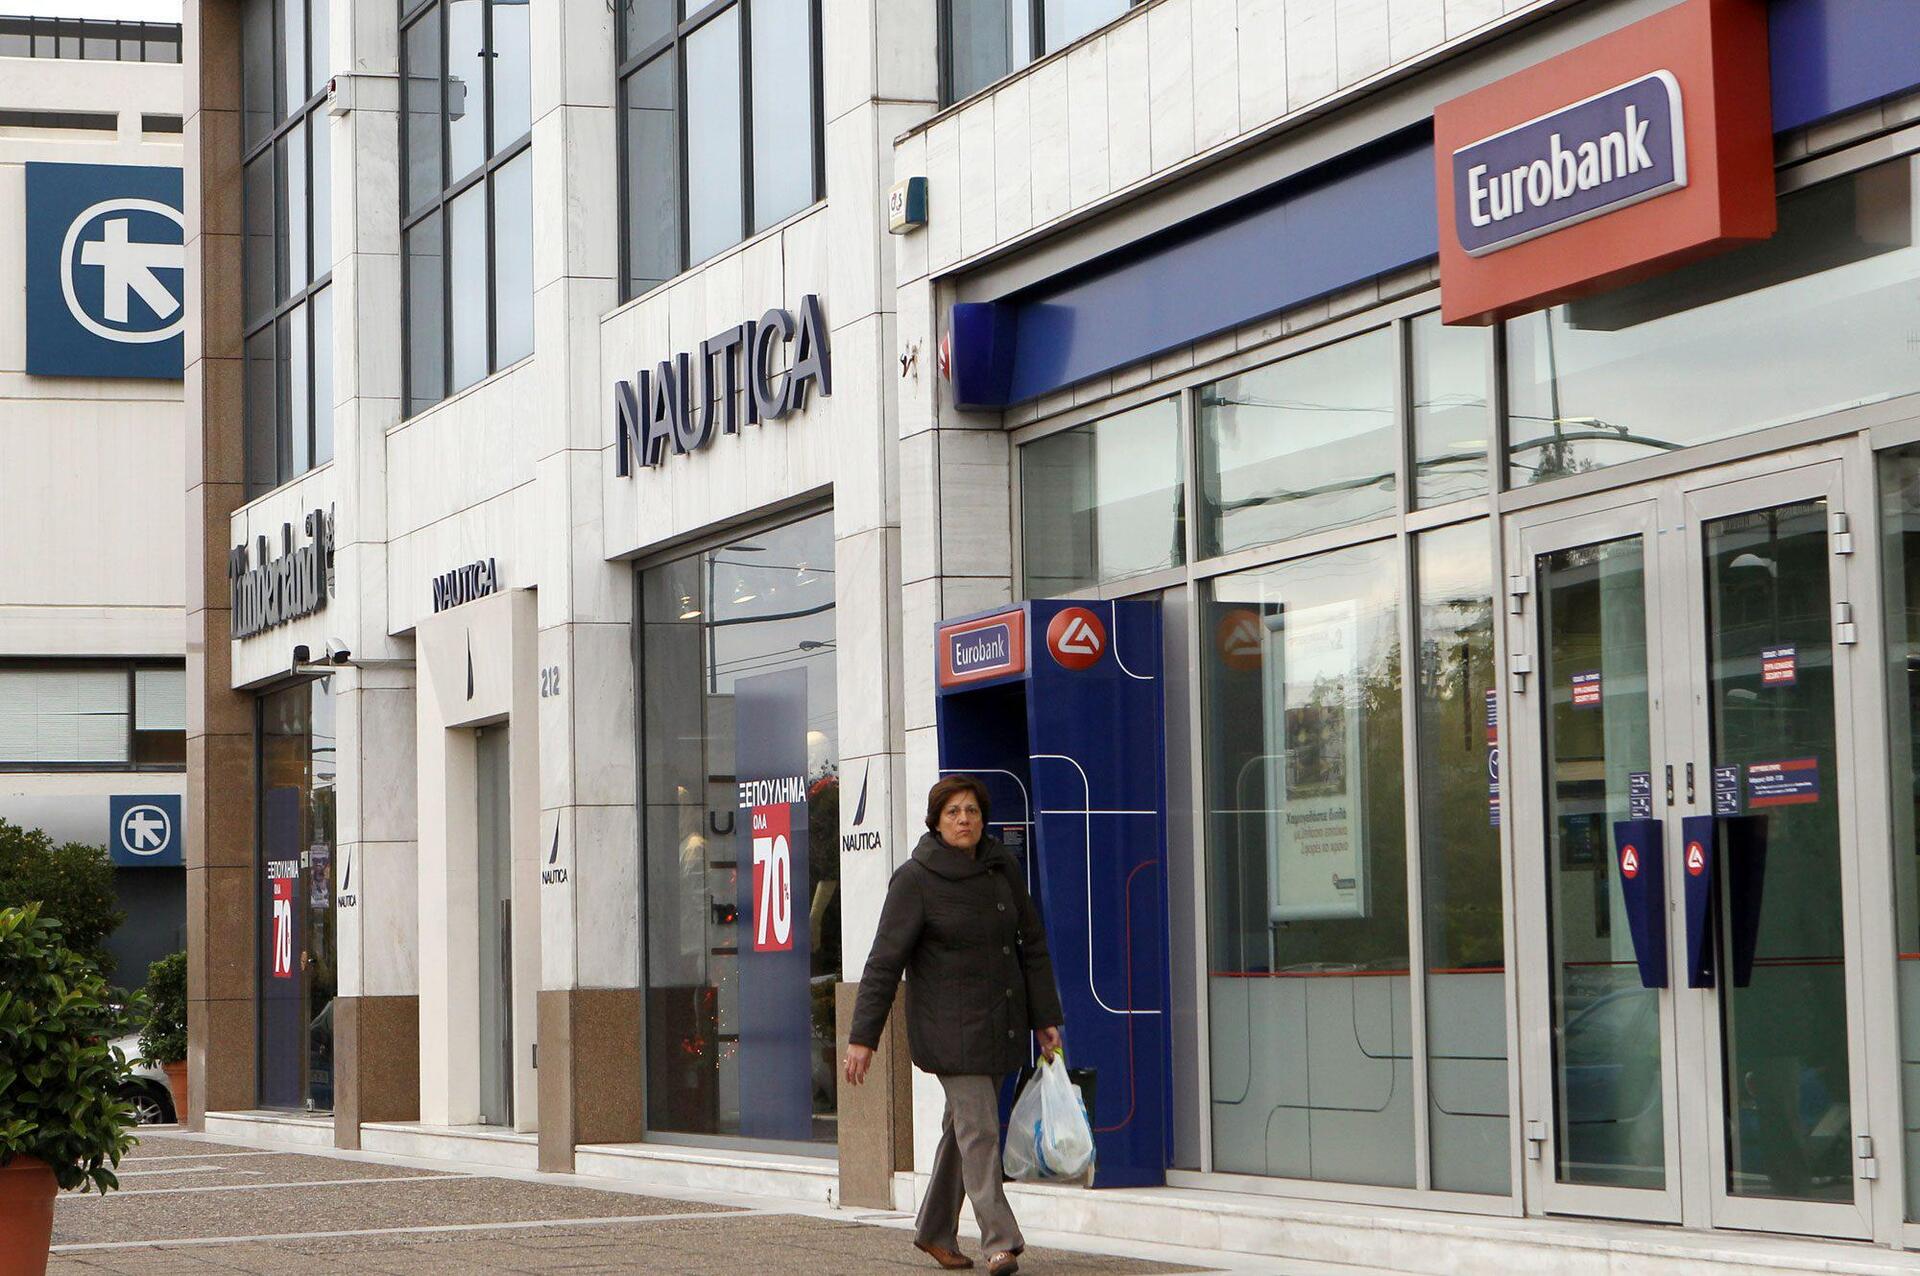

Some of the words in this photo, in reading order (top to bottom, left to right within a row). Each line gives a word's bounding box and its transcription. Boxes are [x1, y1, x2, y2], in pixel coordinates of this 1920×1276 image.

[1468, 105, 1654, 228] Eurobank
[614, 294, 832, 478] NAUTICA
[229, 508, 327, 640] Timberland
[433, 557, 497, 614] NAUTICA
[956, 633, 1005, 666] Eurobank
[541, 665, 560, 698] 212
[739, 776, 806, 808] ΞΕΠΟΥΛΗΜΑ
[842, 832, 881, 852] NAUTICA
[542, 868, 568, 885] NAUTICA
[753, 835, 791, 945] 70
[273, 899, 291, 974] 70
